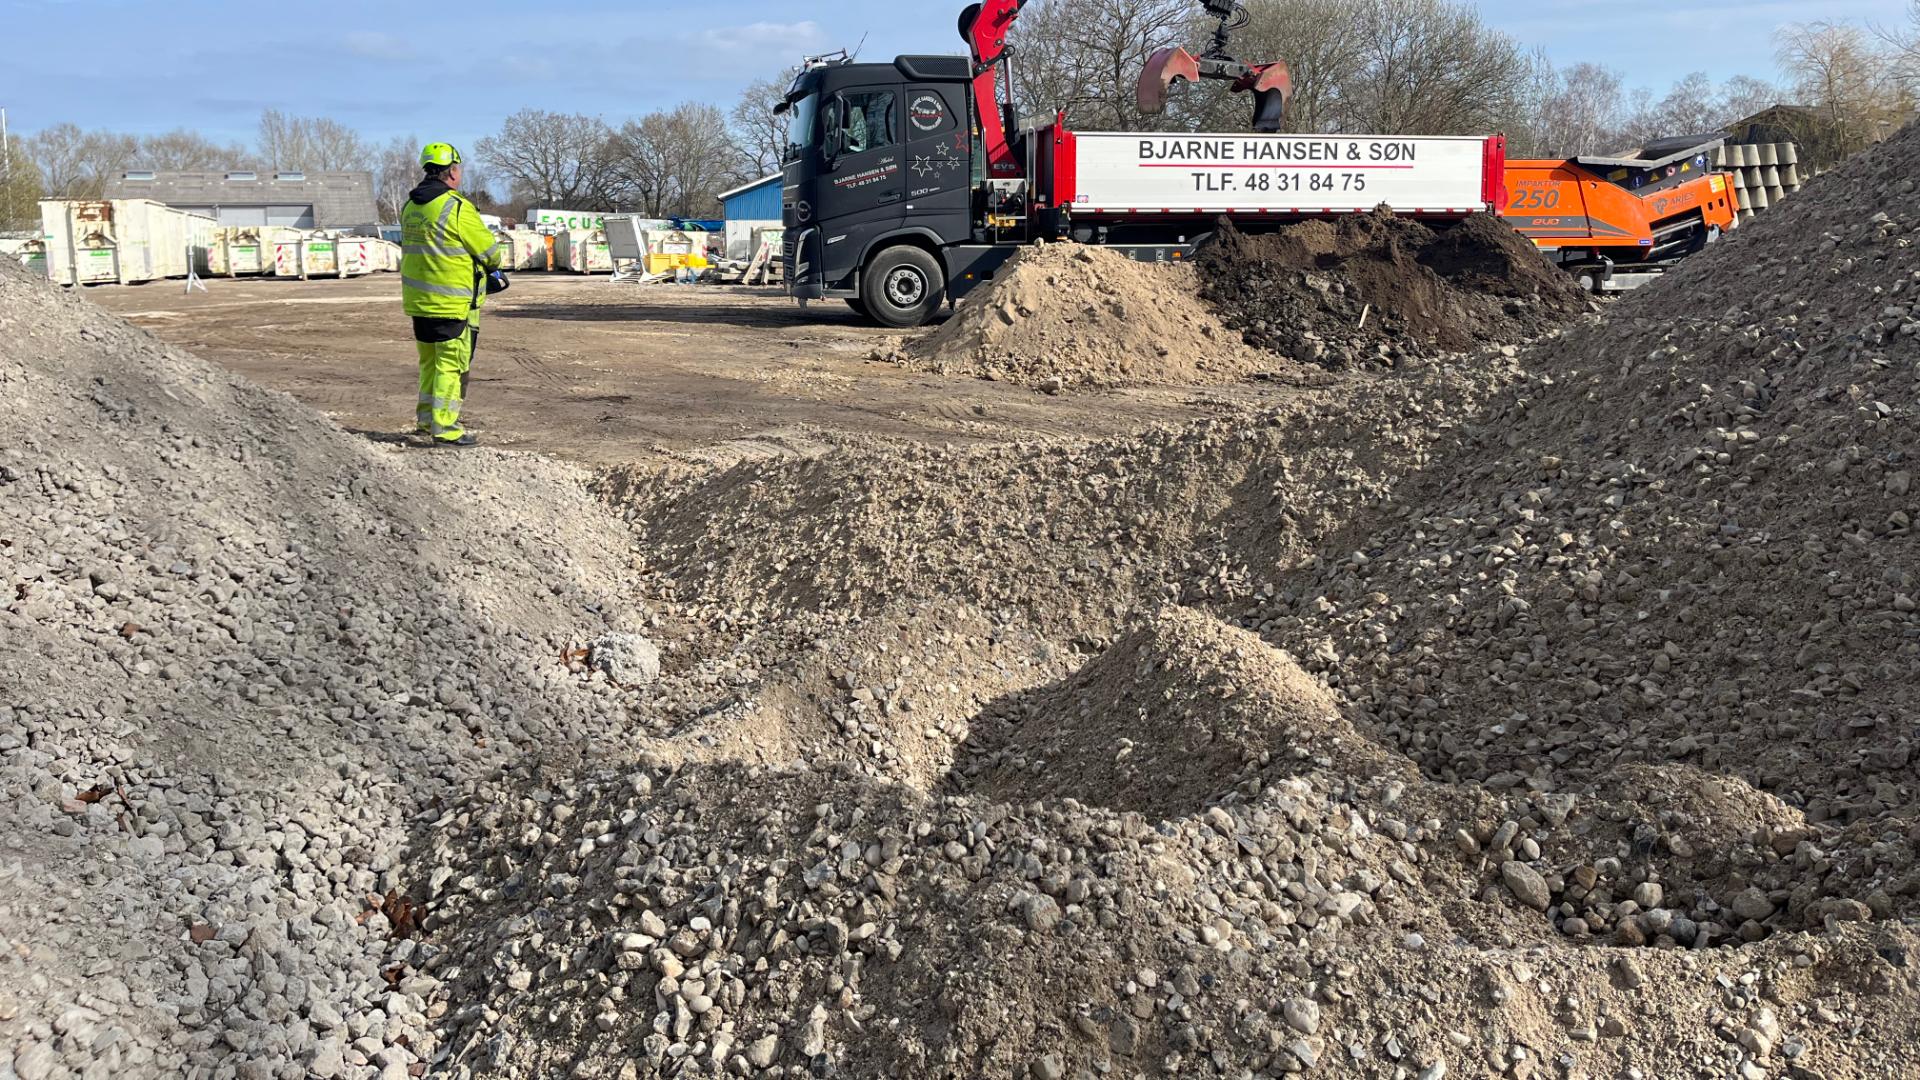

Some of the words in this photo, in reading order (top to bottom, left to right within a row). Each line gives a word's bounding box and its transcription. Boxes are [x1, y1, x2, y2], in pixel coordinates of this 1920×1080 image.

[1138, 140, 1235, 160] BJARNE
[1243, 142, 1339, 161] HANSEN
[1346, 142, 1361, 161] &
[1368, 142, 1416, 162] SØN
[833, 174, 857, 185] BJARNE
[857, 168, 880, 179] HANSEN
[1191, 172, 1237, 192] TLF.
[1244, 172, 1270, 192] 48
[1277, 172, 1300, 192] 31
[1308, 173, 1334, 192] 84
[1340, 173, 1366, 192] 75
[1511, 188, 1560, 209] 250
